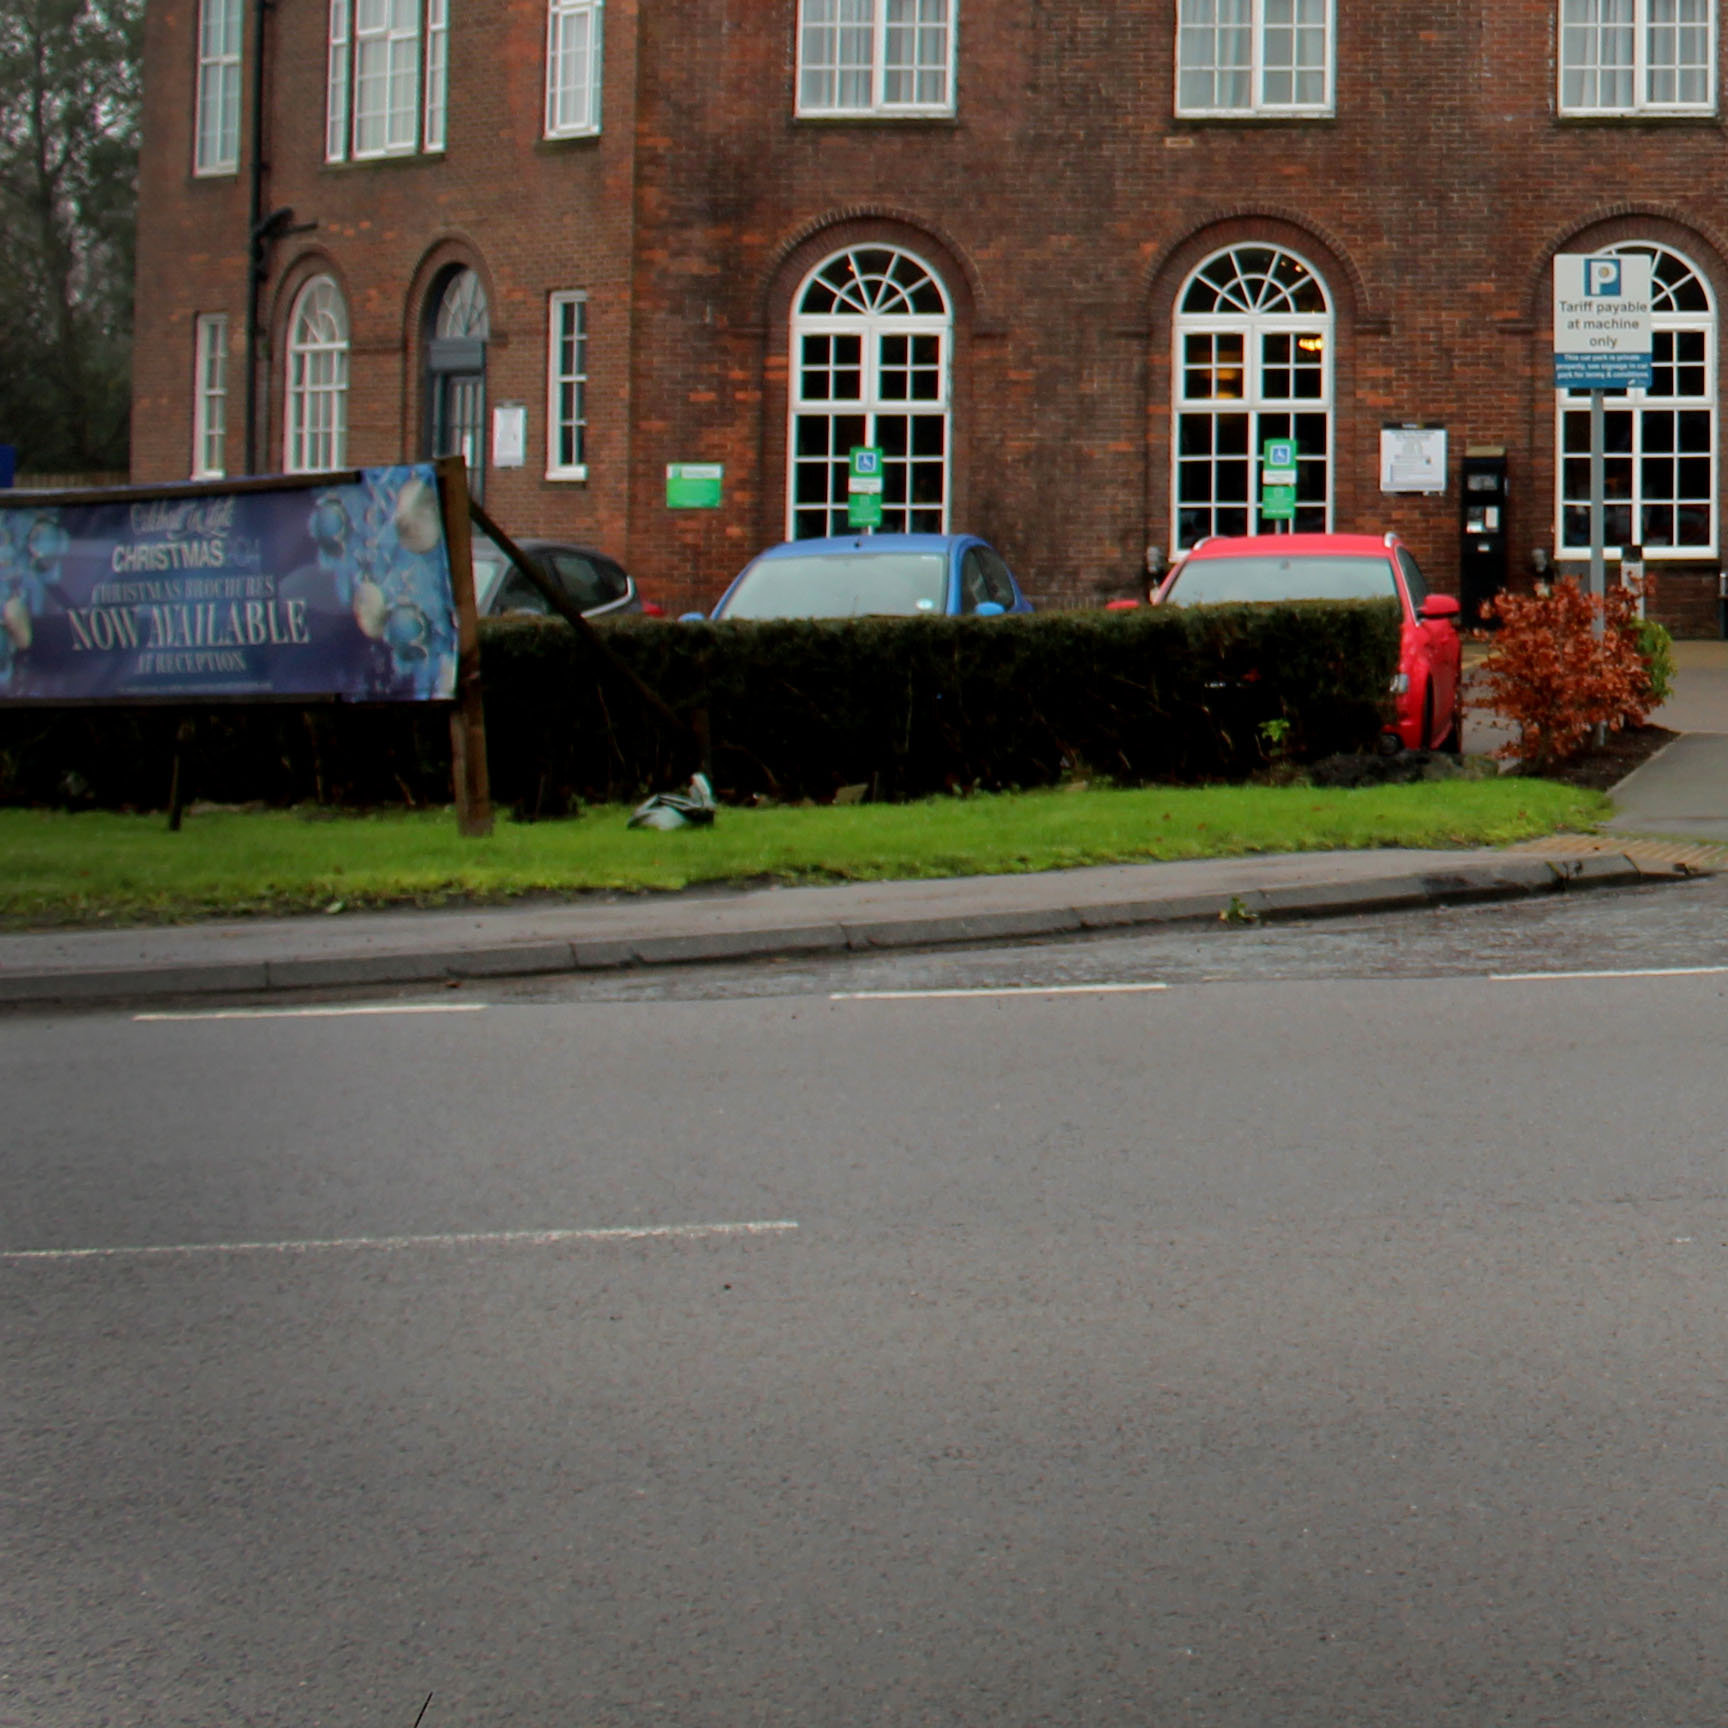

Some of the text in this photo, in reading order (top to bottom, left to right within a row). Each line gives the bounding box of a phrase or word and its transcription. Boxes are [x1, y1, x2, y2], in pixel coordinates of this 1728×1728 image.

[1590, 261, 1618, 296] P
[1560, 300, 1648, 314] Tariff payable
[1567, 318, 1639, 330] at machine
[1589, 336, 1618, 348] only
[112, 539, 225, 573] CHRISTMAS
[91, 575, 276, 605] CHRISTMAS BROCHURES
[67, 599, 311, 652] NOW AVAILABLE
[155, 650, 247, 674] RECEPTION
